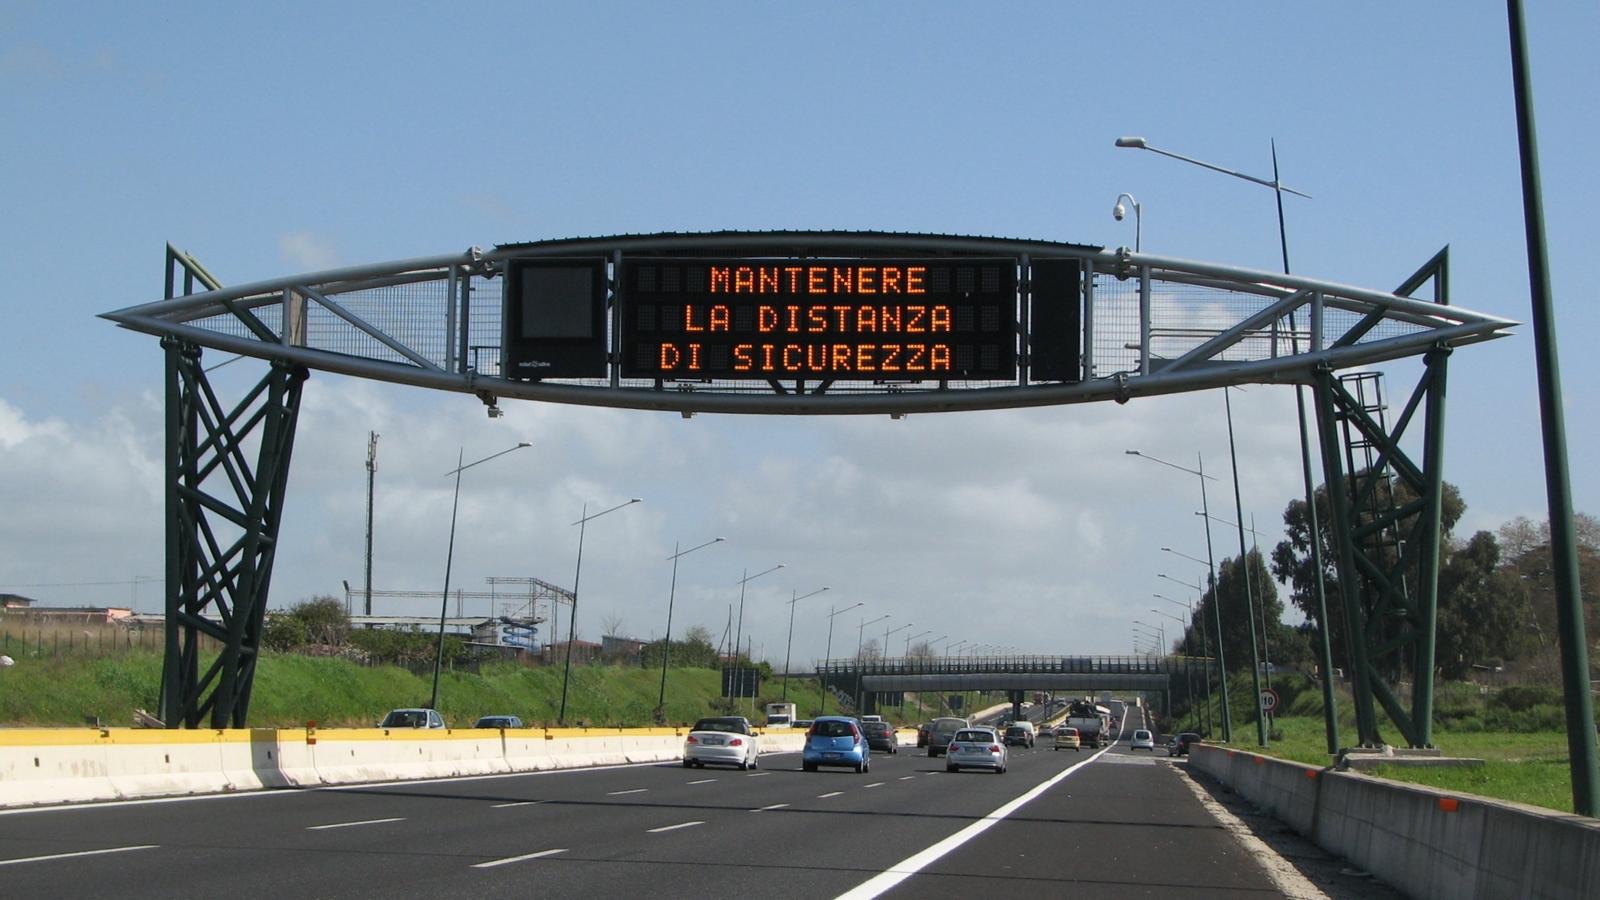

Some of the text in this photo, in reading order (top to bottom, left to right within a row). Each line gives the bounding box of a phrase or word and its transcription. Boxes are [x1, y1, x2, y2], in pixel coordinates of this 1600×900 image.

[710, 266, 926, 293] MANTENERE
[685, 304, 951, 332] LA DISTANZA
[660, 343, 951, 371] DI SICUREZZA
